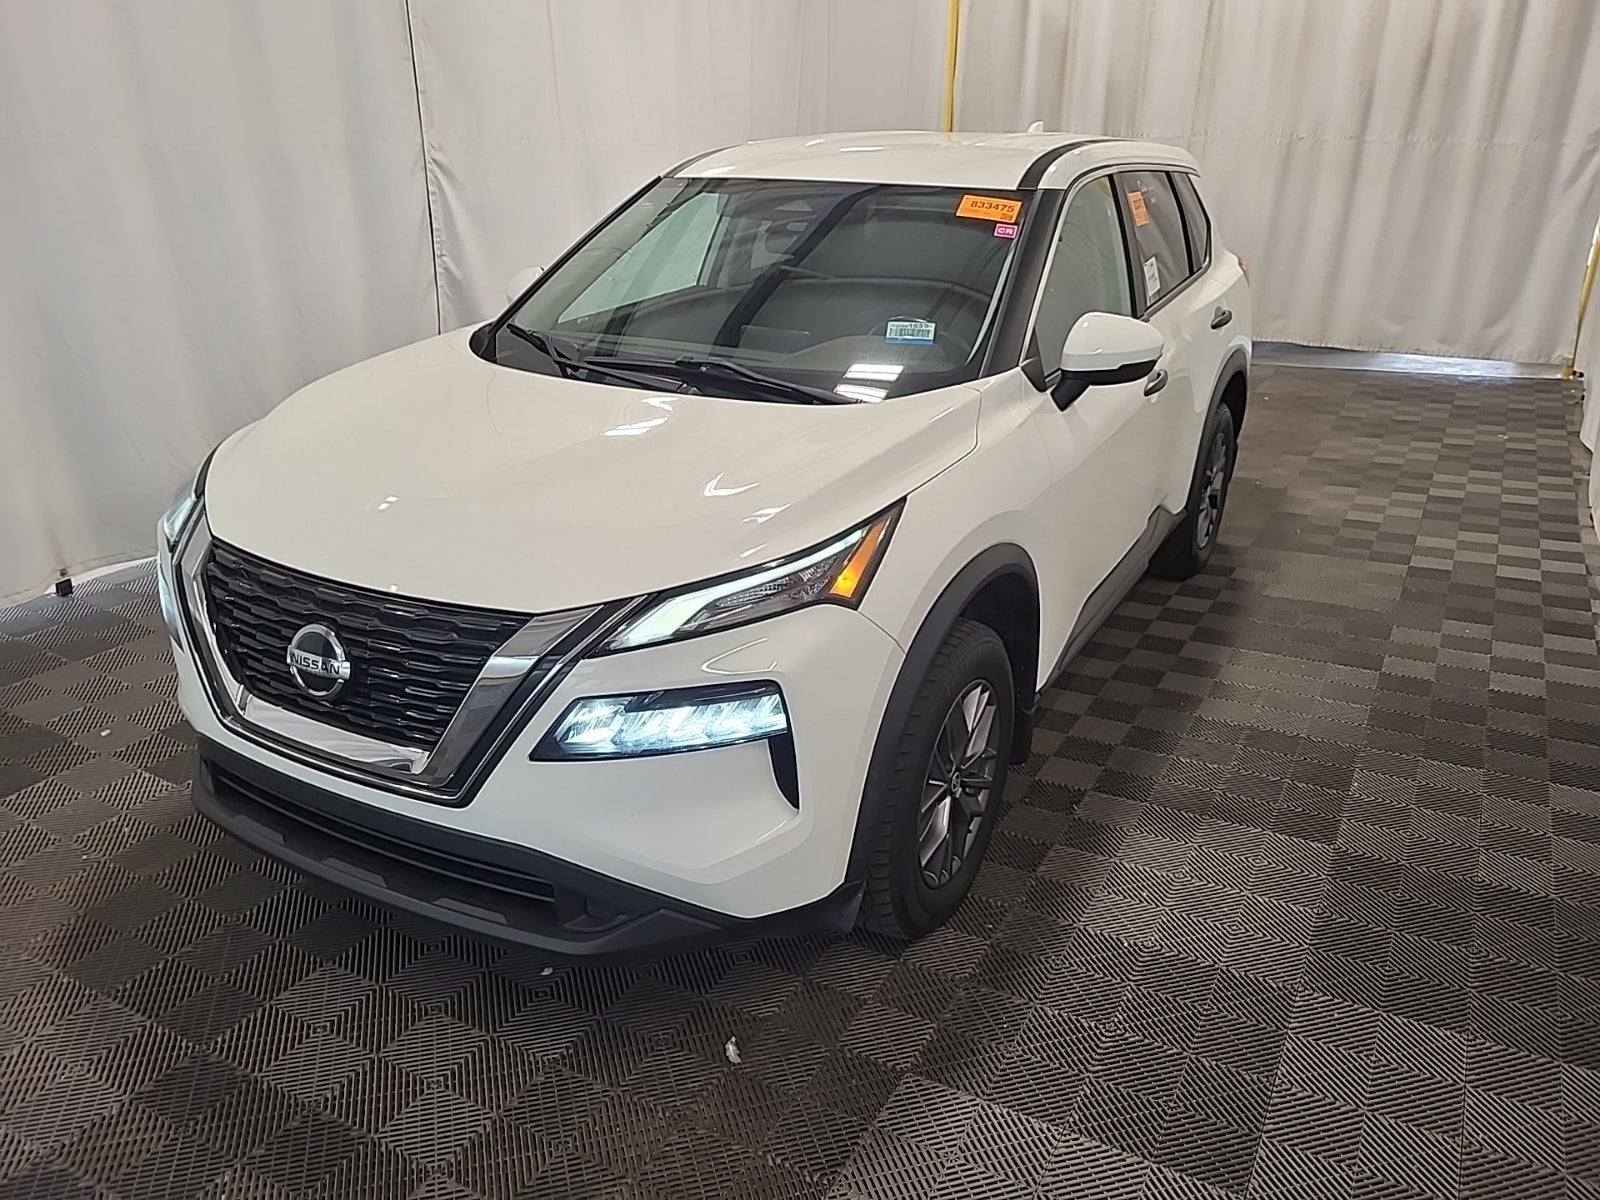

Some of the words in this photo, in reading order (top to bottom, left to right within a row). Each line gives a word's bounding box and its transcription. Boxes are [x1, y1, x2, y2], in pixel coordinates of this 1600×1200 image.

[970, 200, 1015, 212] 833475
[997, 227, 1014, 235] CR
[290, 653, 340, 675] NISSAN
